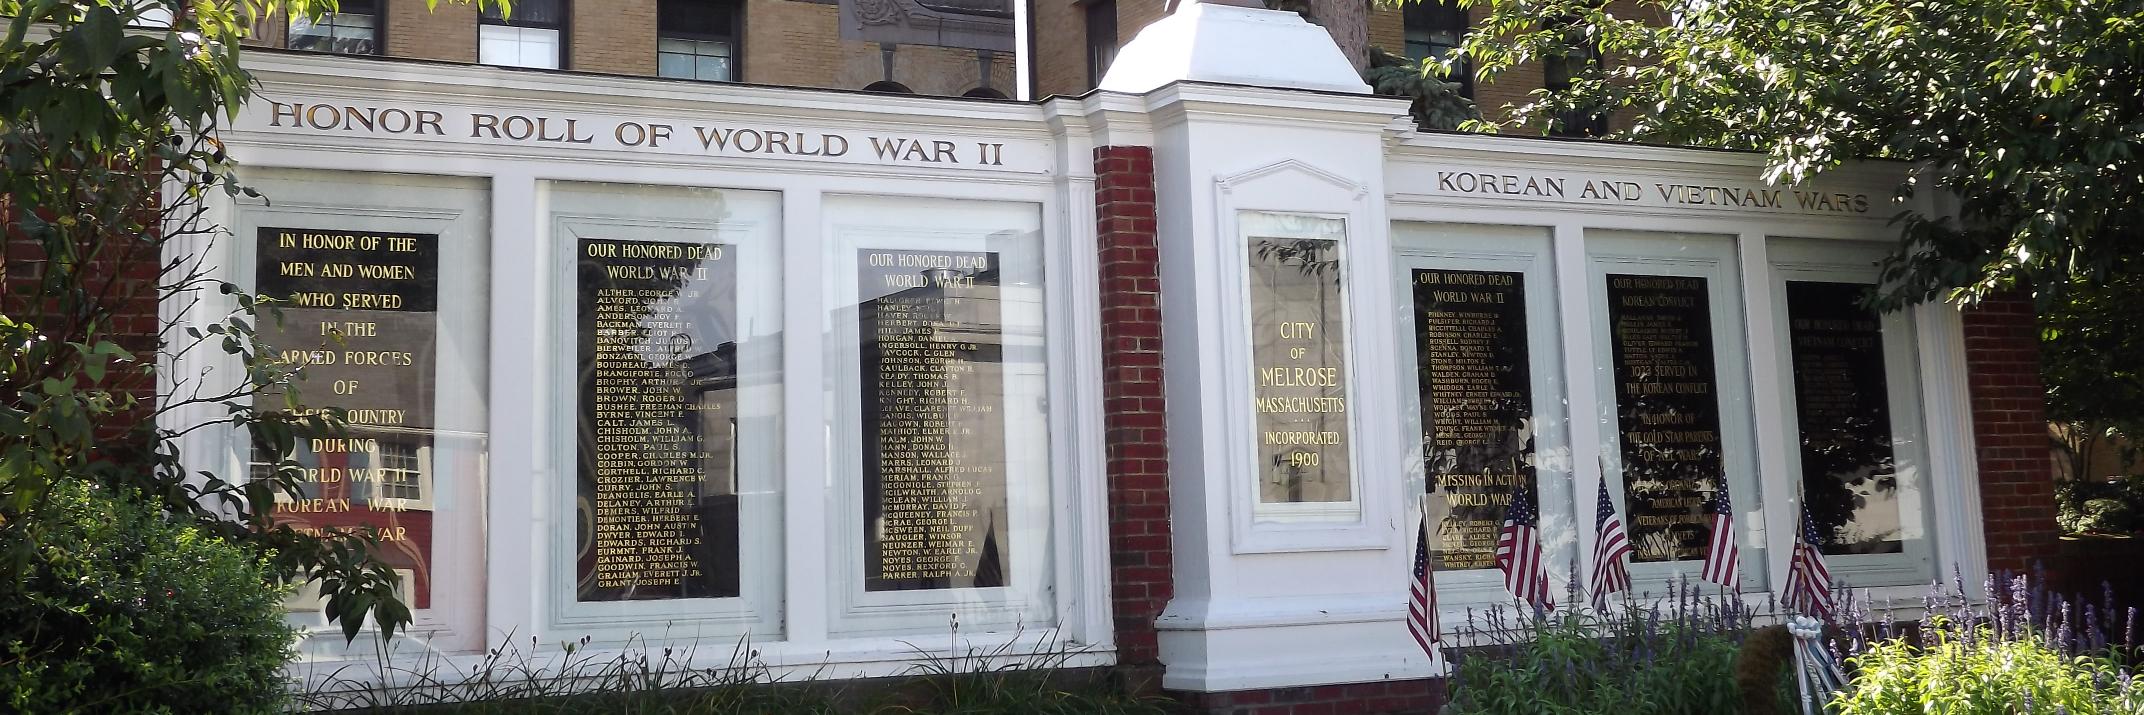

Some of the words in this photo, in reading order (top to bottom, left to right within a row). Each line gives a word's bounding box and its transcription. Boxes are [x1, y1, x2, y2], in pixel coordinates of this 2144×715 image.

[270, 102, 446, 135] HONOR
[470, 114, 594, 143] ROLL
[615, 121, 675, 148] OF
[693, 127, 849, 157] WORLD
[868, 137, 958, 163] WAR
[977, 143, 1003, 165] II
[1438, 171, 1566, 198] KOREAN
[1580, 179, 1642, 201] AND
[1655, 183, 1782, 209] VIETNAM
[1793, 190, 1870, 213] WARS
[280, 233, 296, 248] IN
[303, 234, 355, 250] HONOR
[360, 236, 381, 250] OF
[388, 238, 417, 251] THE
[588, 244, 617, 258] OUR
[622, 244, 682, 259] HONORED
[688, 247, 721, 260] DEAD
[869, 254, 894, 267] OUR
[899, 255, 951, 268] HONORED
[957, 256, 985, 268] DEAD
[280, 262, 314, 277] MEN
[321, 264, 353, 277] AND
[358, 265, 415, 279] WOMEN
[607, 265, 656, 279] WORLD
[659, 267, 688, 279] WAR
[696, 268, 707, 280] II
[885, 275, 928, 287] WORLD
[935, 276, 961, 288] WAR
[965, 277, 975, 288] II
[1421, 273, 1440, 283] OUR
[1444, 273, 1485, 285] HONORED
[1489, 275, 1512, 286] DEAD
[299, 293, 335, 306] WHO
[343, 293, 402, 308] SERVED
[1434, 290, 1467, 302] WORLD
[1471, 293, 1493, 303] WAR
[1497, 293, 1504, 303] II
[345, 322, 376, 336] THE
[1280, 322, 1314, 339] CITY
[280, 350, 336, 365] ARMED
[345, 352, 412, 365] FORCES
[1290, 348, 1306, 359] OF
[1261, 368, 1337, 387] MELROSE
[334, 380, 358, 394] OF
[1643, 383, 1673, 393] KOREAN
[1256, 396, 1344, 413] MASSACHUSETTS
[348, 409, 406, 424] OUNTRY
[1265, 431, 1339, 445] INCORPORATED
[1644, 432, 1663, 442] GOLD
[312, 439, 375, 452] DURING
[1291, 452, 1319, 467] 1900
[299, 469, 341, 482] ORLD
[349, 469, 386, 482] WAR
[395, 469, 406, 481] II
[1438, 475, 1482, 486] MISSING
[1484, 475, 1493, 485] IN
[277, 499, 349, 512] KOREAN
[368, 499, 407, 512] WAR
[1446, 494, 1487, 506] WORLD
